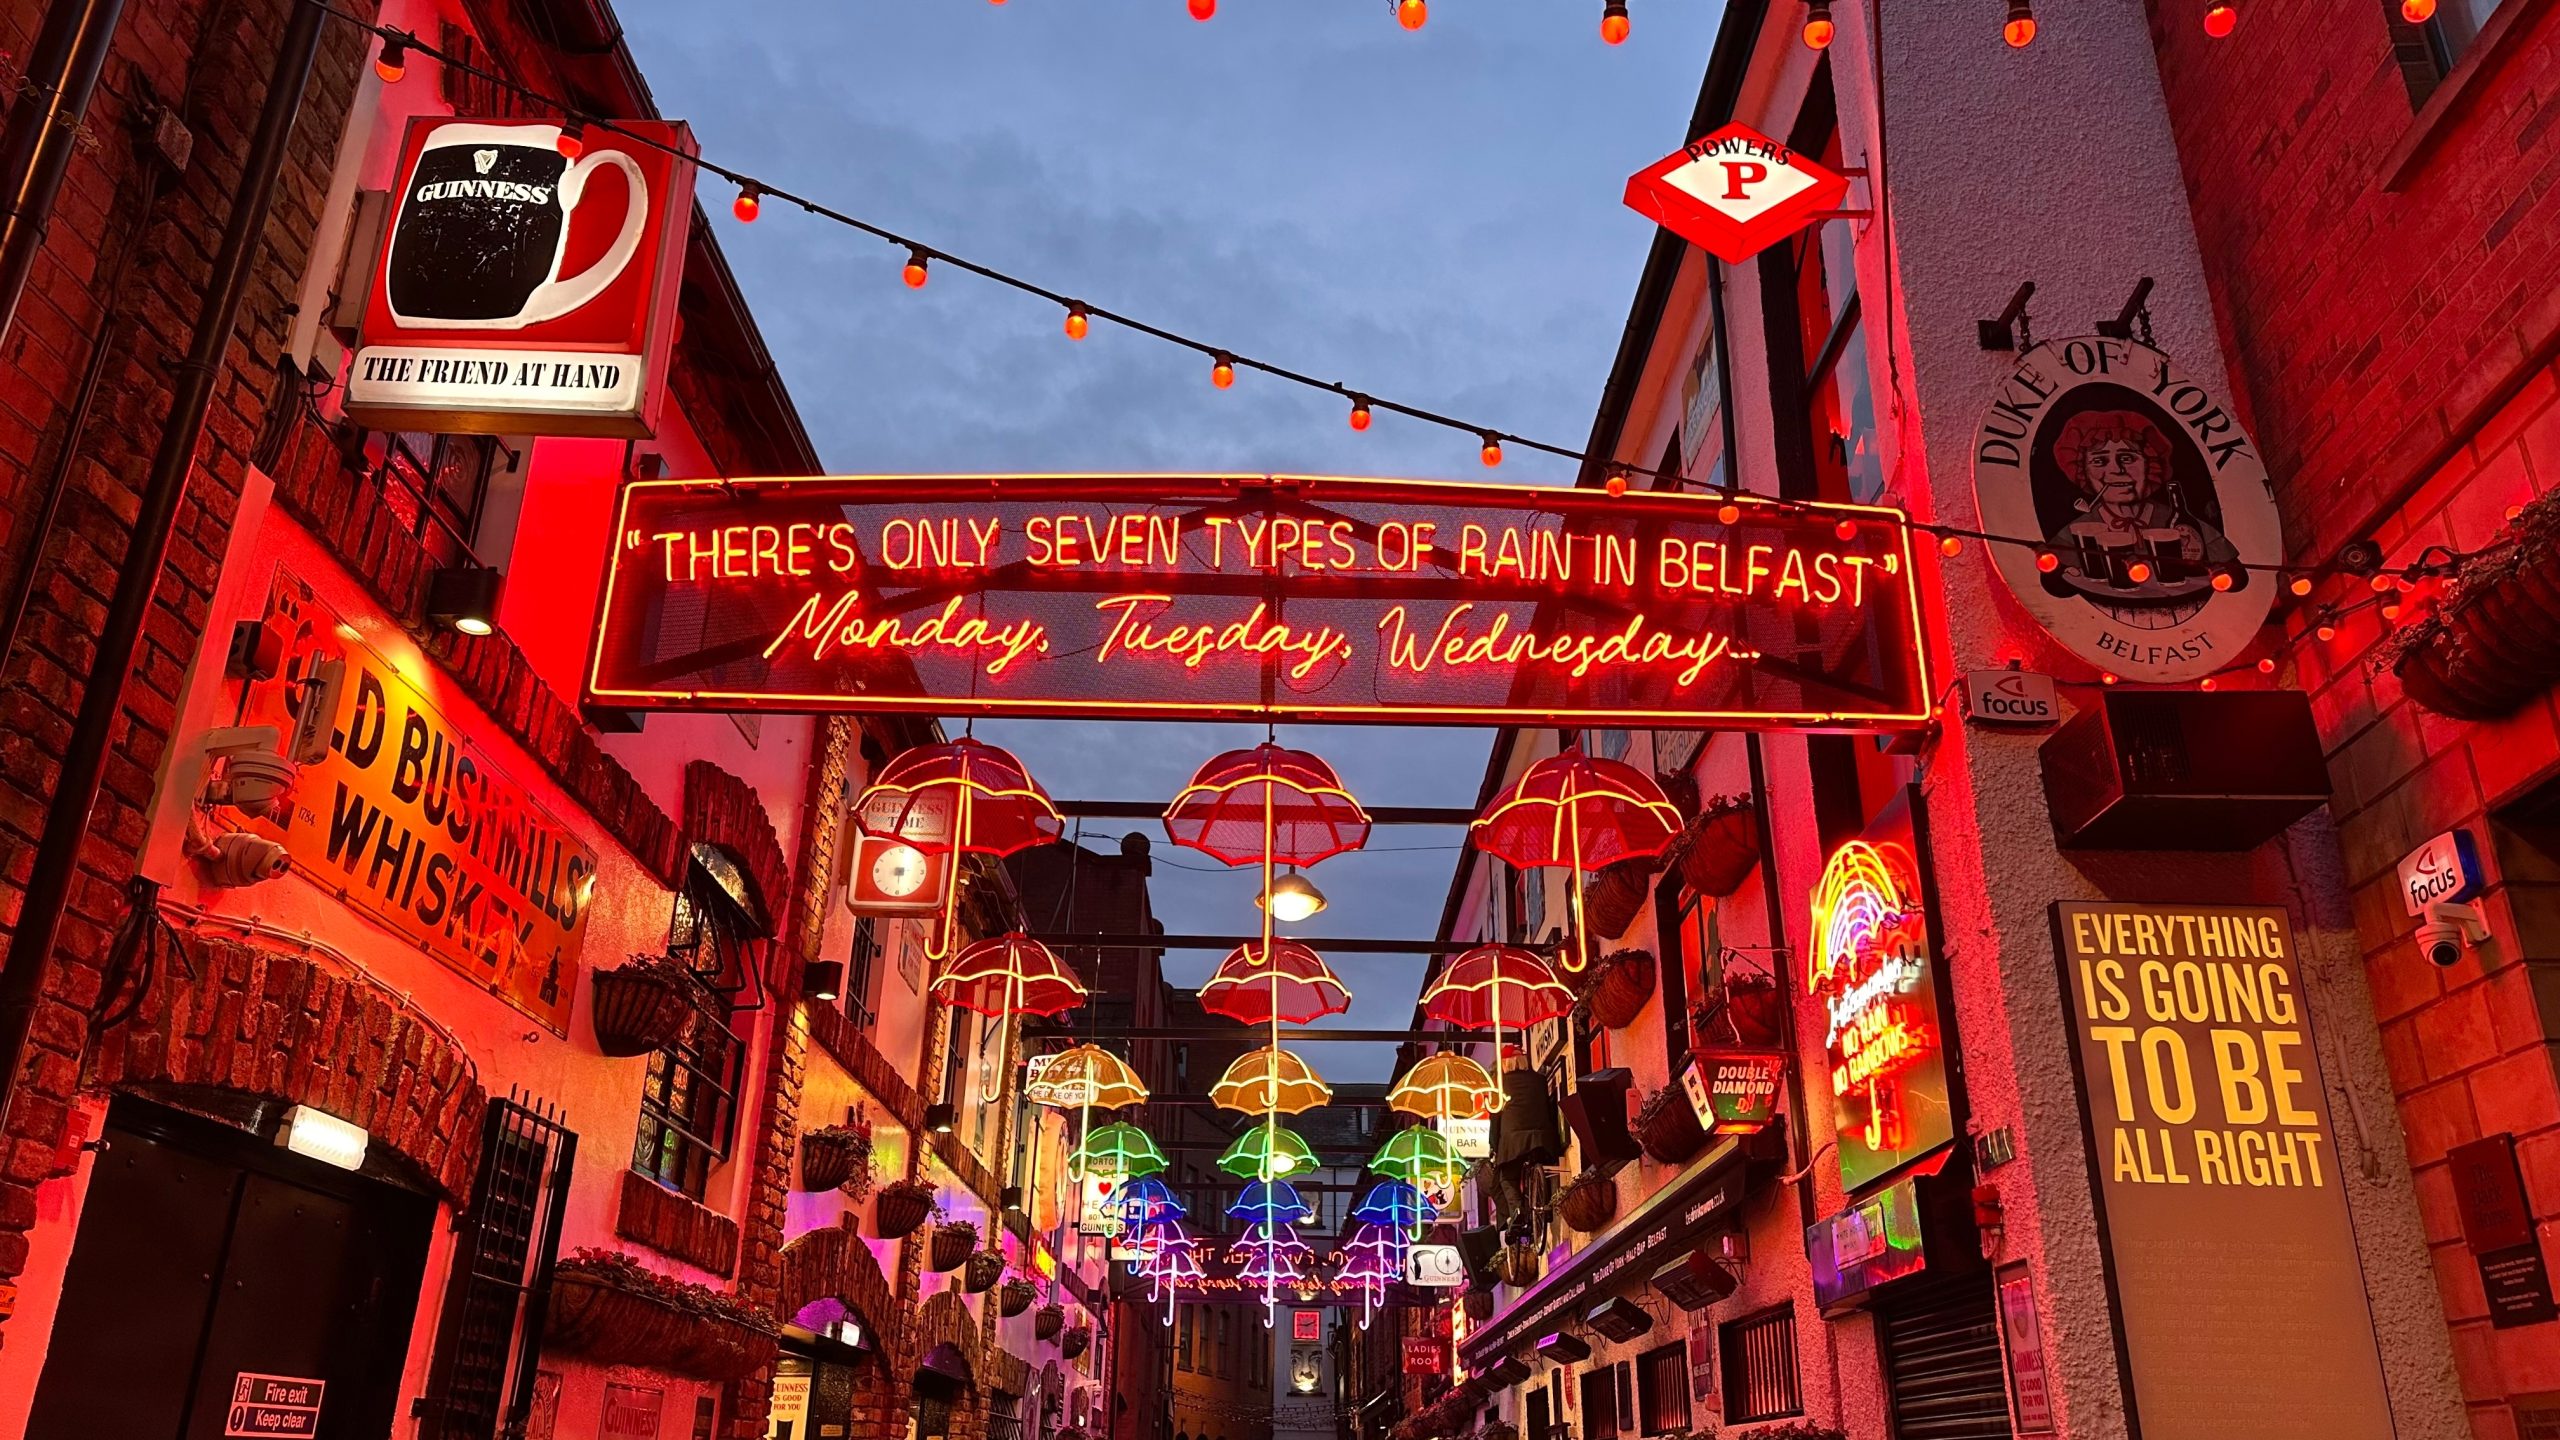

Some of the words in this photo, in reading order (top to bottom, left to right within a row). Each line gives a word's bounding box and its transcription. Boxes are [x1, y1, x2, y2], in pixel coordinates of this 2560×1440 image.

[1685, 136, 1795, 166] POWERS
[417, 180, 551, 206] GUINNESS
[1719, 161, 1768, 200] P
[363, 357, 413, 382] THE
[416, 359, 508, 386] FRIEND
[512, 362, 547, 387] AT
[551, 363, 620, 390] HAND
[1980, 363, 2060, 469] DUKE
[2064, 341, 2126, 376] OF
[2149, 364, 2255, 472] YORK
[882, 517, 998, 570] ONLY
[1025, 515, 1181, 567] SEVEN
[1204, 516, 1358, 571] TYPES
[1377, 521, 1437, 572] OF
[1459, 523, 1572, 583] RAIN
[1594, 533, 1637, 588] IN
[763, 590, 1049, 676] Monday,
[1095, 593, 1353, 679] Tuesday,
[2097, 630, 2214, 666] BELFAST
[1982, 691, 2049, 717] focus
[888, 816, 925, 828] TME
[2410, 867, 2457, 909] focus
[2072, 912, 2284, 959] EVERYTHING
[2079, 959, 2131, 1021] IS
[2139, 961, 2298, 1024] GOING
[1842, 1027, 1859, 1058] NO
[1860, 1002, 1889, 1043] RAIN
[1718, 1066, 1769, 1080] DOUBLE
[1832, 1064, 1848, 1096] NO
[1848, 1022, 1908, 1083] RAINBOWS
[1712, 1081, 1774, 1094] DIAMOND
[2090, 1026, 2197, 1125] TO
[2210, 1029, 2318, 1126] BE
[1457, 1139, 1477, 1147] BAR
[2113, 1128, 2190, 1184] ALL
[2194, 1130, 2323, 1187] RIGHT
[1424, 1274, 1460, 1283] GUINNESS
[1408, 1345, 1441, 1353] LADIES
[265, 1382, 286, 1402] Fire
[288, 1386, 308, 1405] exit
[2020, 1379, 2027, 1391] IS
[2026, 1377, 2042, 1390] GOOD
[788, 1403, 801, 1411] YOU
[2022, 1395, 2034, 1408] FOR
[2034, 1394, 2045, 1407] YOU
[255, 1410, 280, 1430] Keep
[281, 1412, 307, 1430] clear
[604, 1398, 658, 1437] GUINNESS
